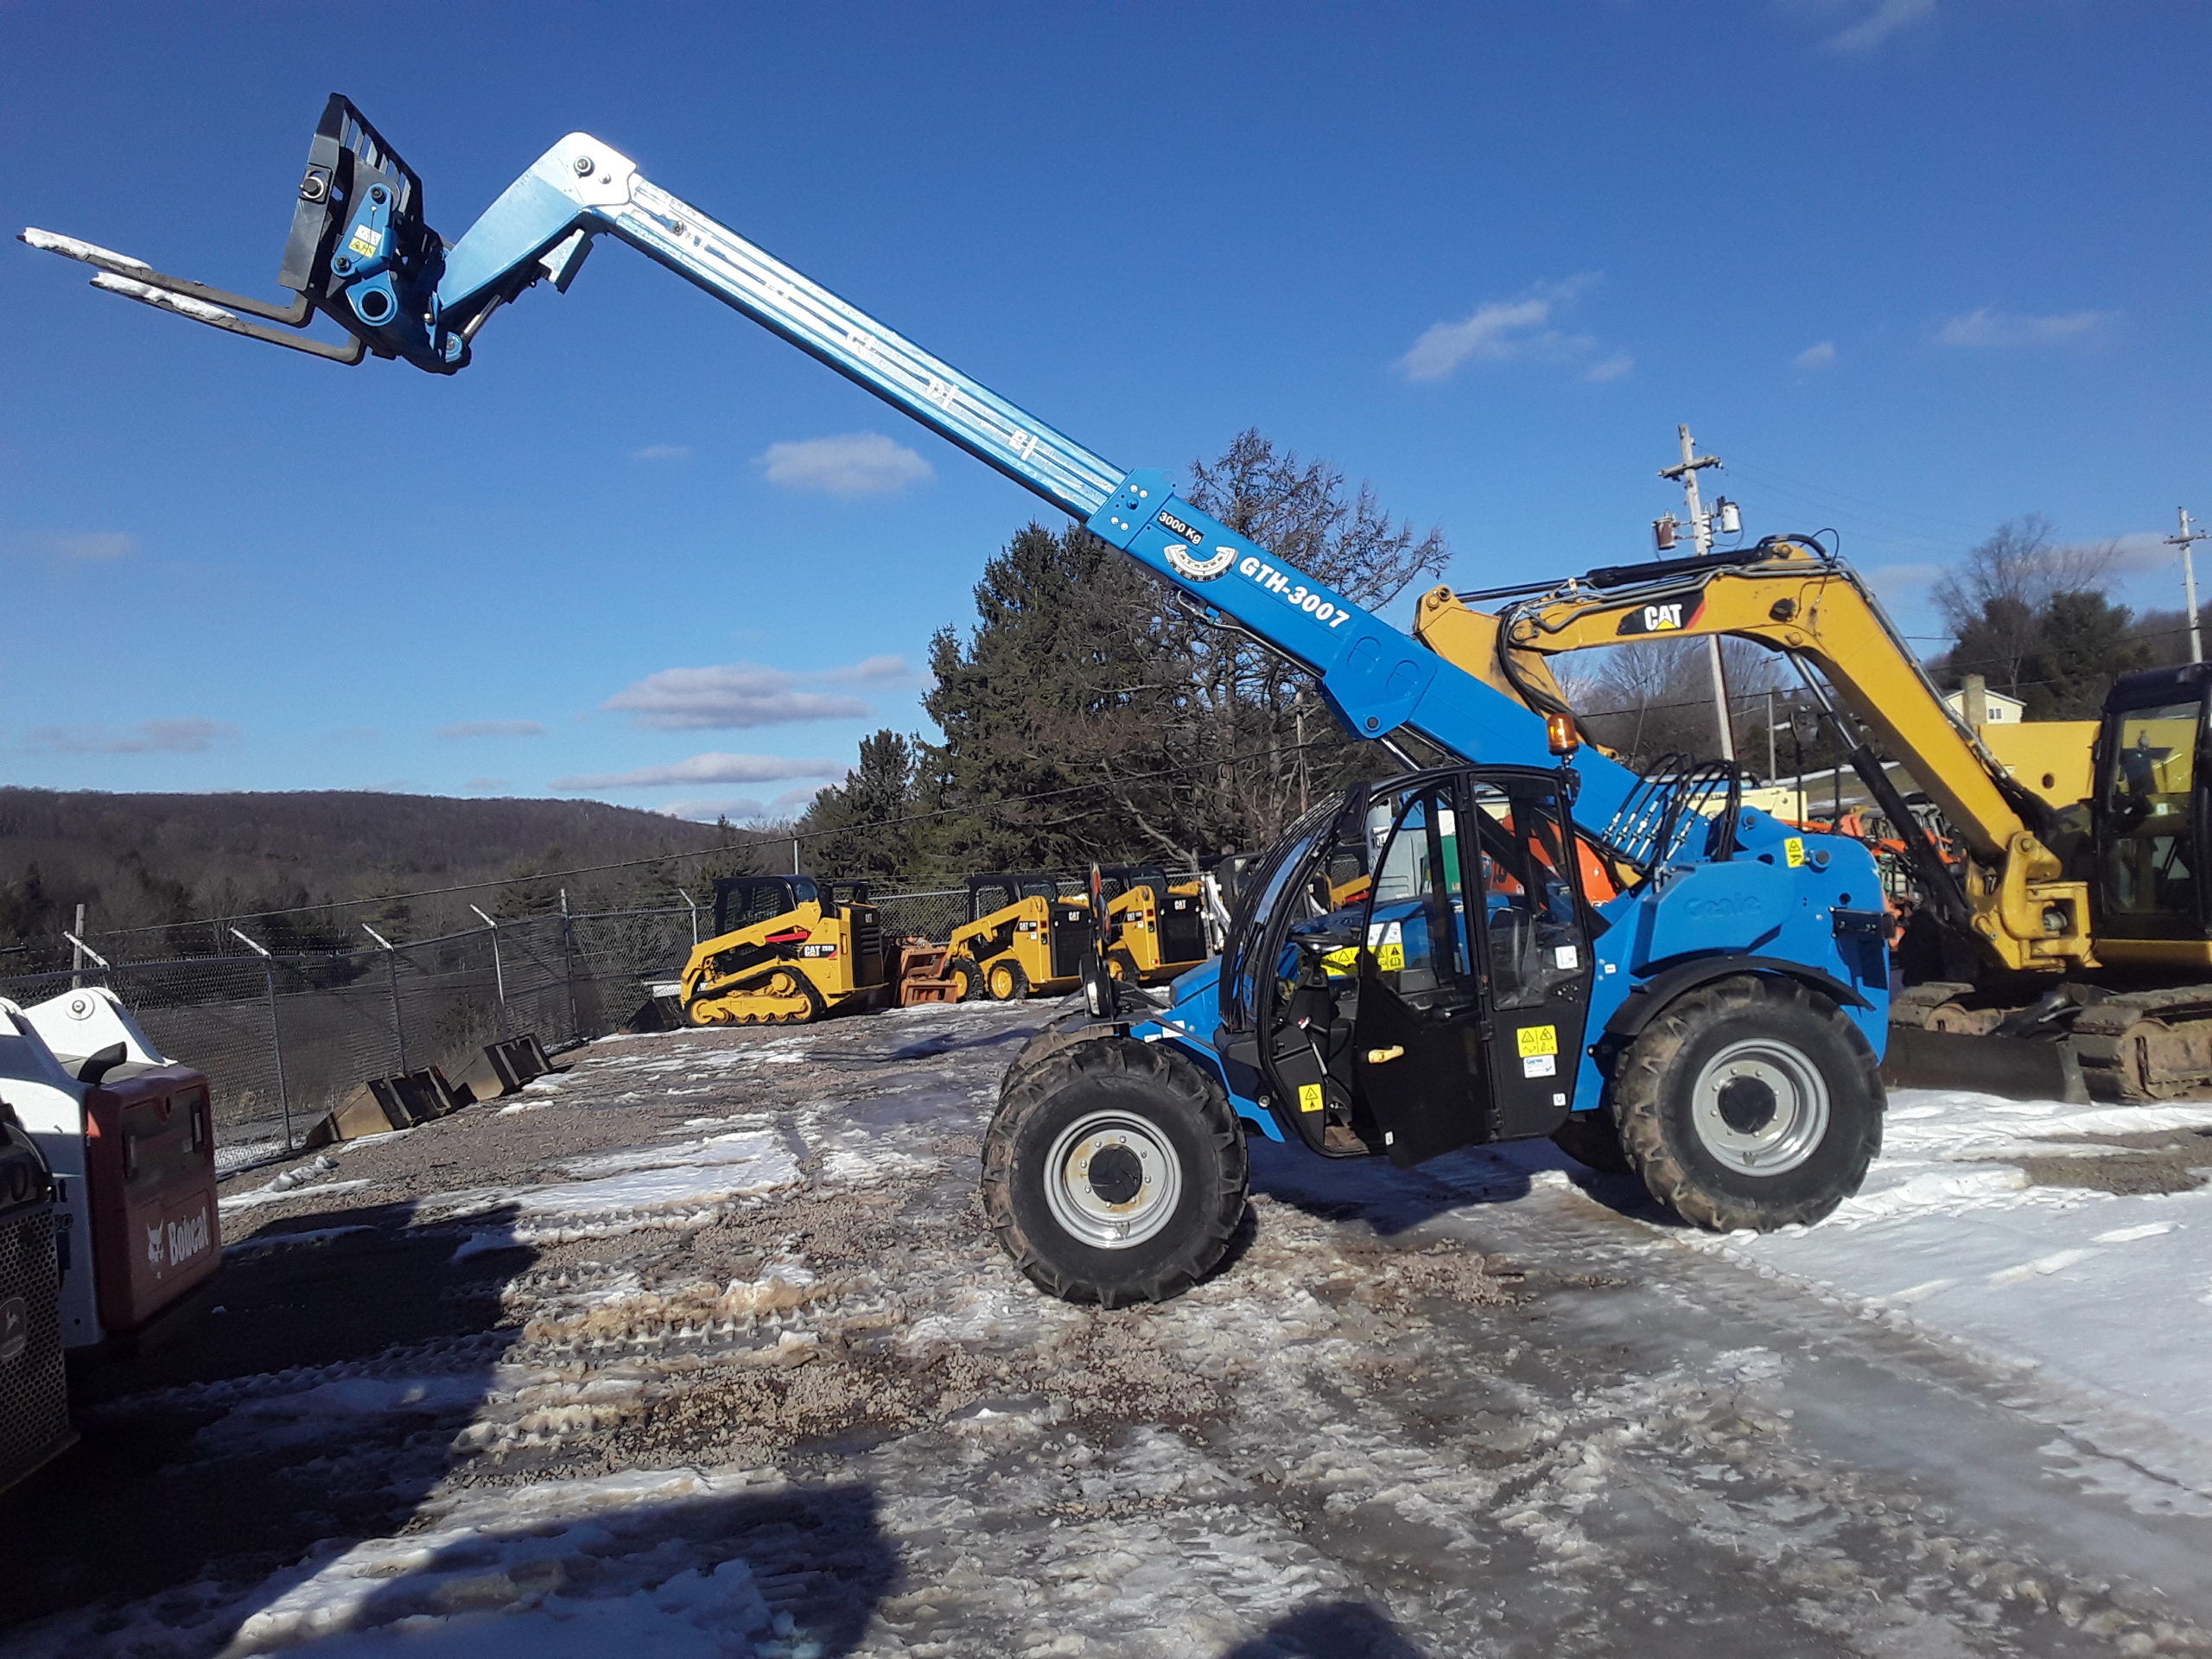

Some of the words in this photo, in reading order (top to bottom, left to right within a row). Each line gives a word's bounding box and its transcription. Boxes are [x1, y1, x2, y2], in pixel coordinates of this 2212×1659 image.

[1159, 512, 1186, 532] 3000
[1185, 527, 1202, 544] Kg
[1239, 556, 1351, 628] GTH-3007
[1644, 604, 1682, 631] CAT
[1174, 899, 1186, 910] CAT
[1068, 912, 1080, 921] CAT
[1019, 922, 1028, 931] CAT
[804, 945, 821, 957] CAT
[168, 1206, 209, 1268] Bobcat
